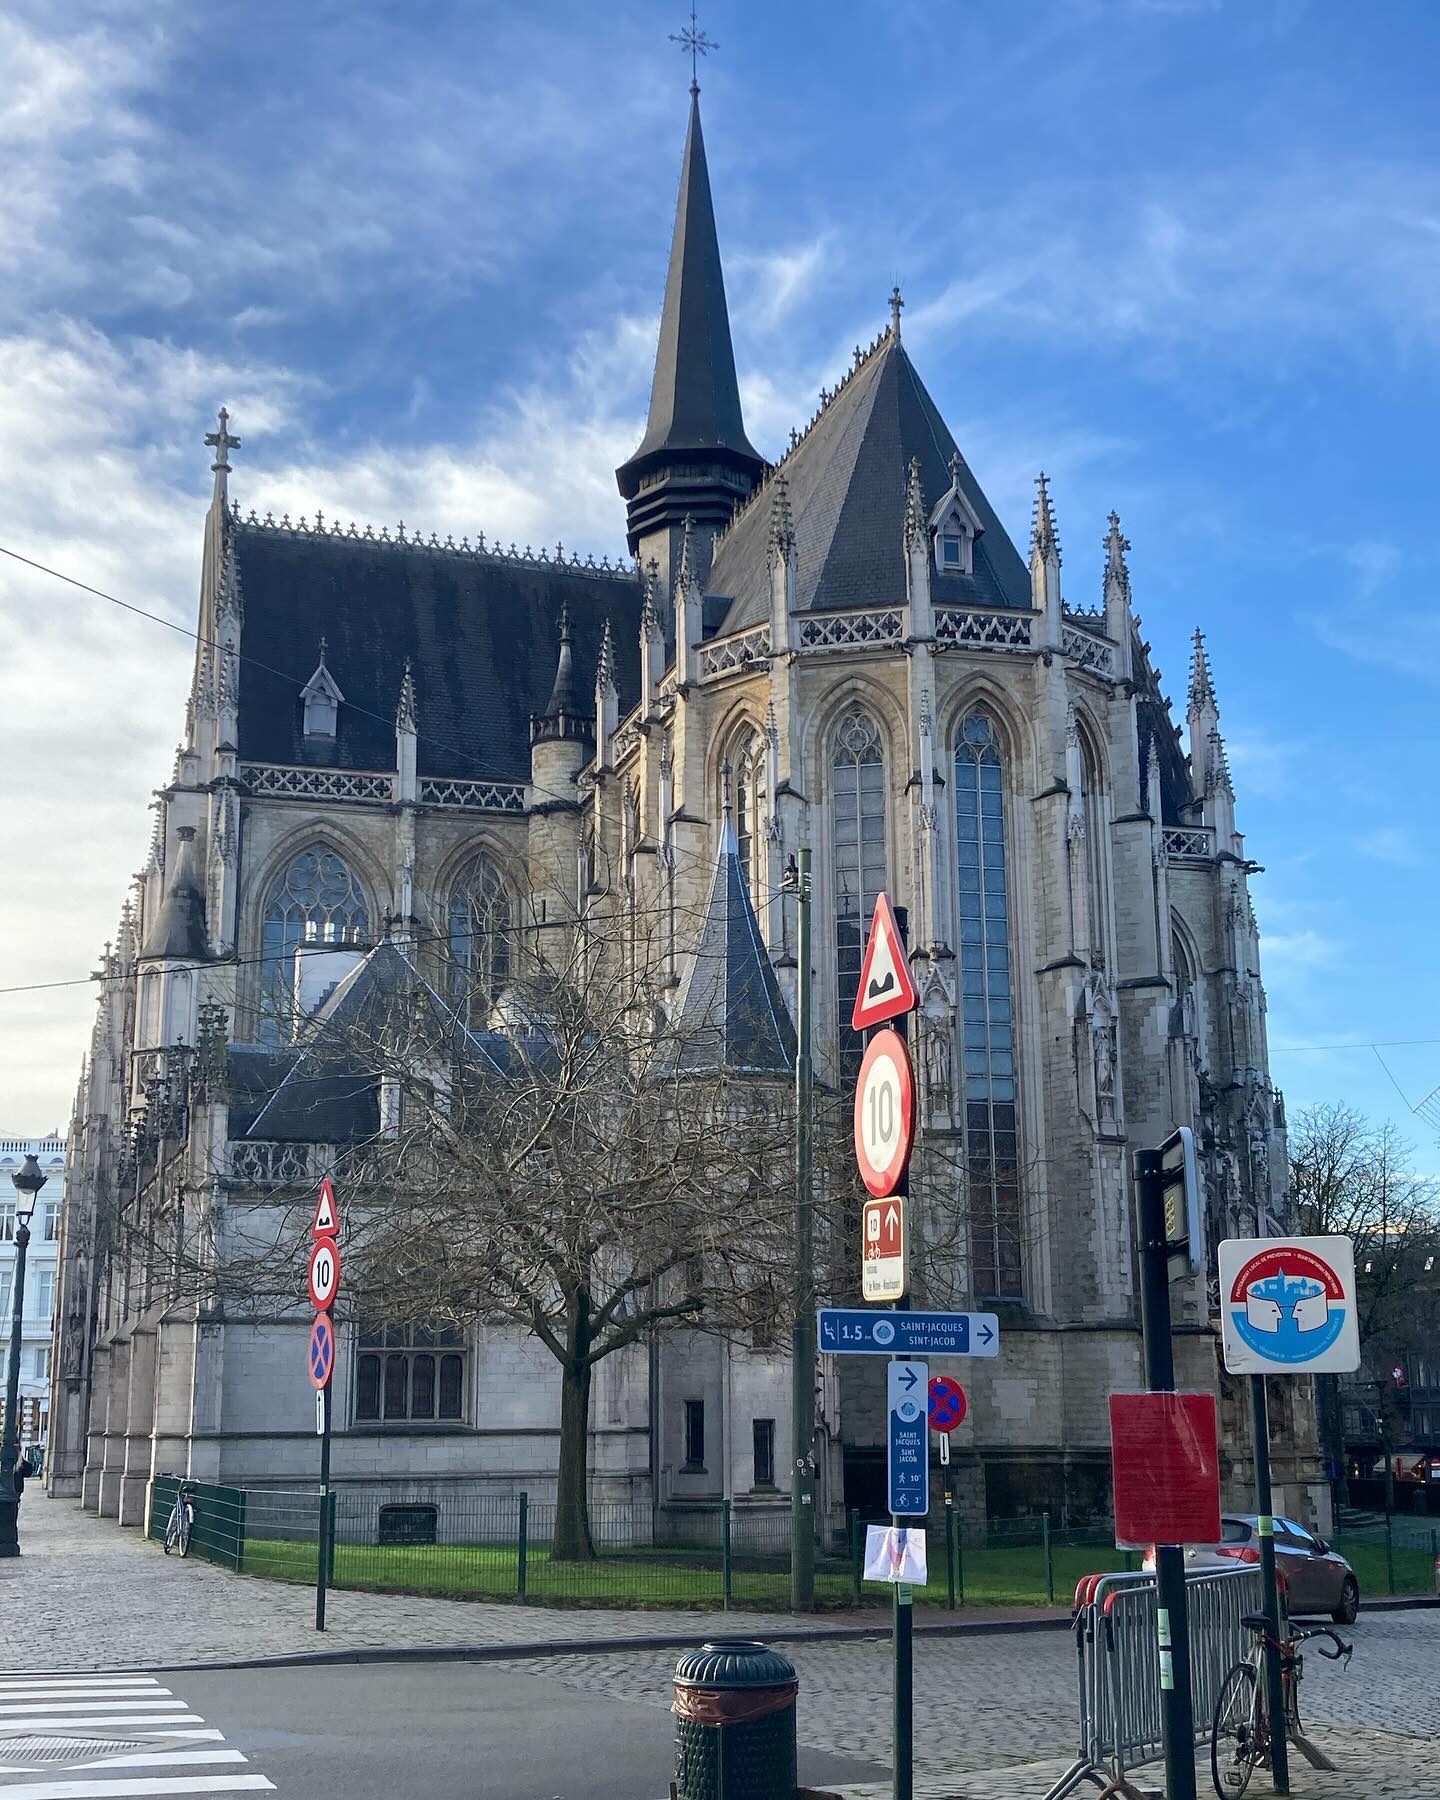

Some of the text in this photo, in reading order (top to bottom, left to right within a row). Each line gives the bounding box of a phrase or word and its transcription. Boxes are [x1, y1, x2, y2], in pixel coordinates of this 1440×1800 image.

[869, 1080, 893, 1146] 10
[870, 1218, 878, 1232] 10
[1249, 1261, 1261, 1272] LOCAL
[317, 1259, 330, 1288] 10
[842, 1325, 862, 1340] 1.5
[899, 1431, 917, 1439] SAINT
[895, 1438, 921, 1446] JACQUES
[901, 1448, 915, 1456] SINT
